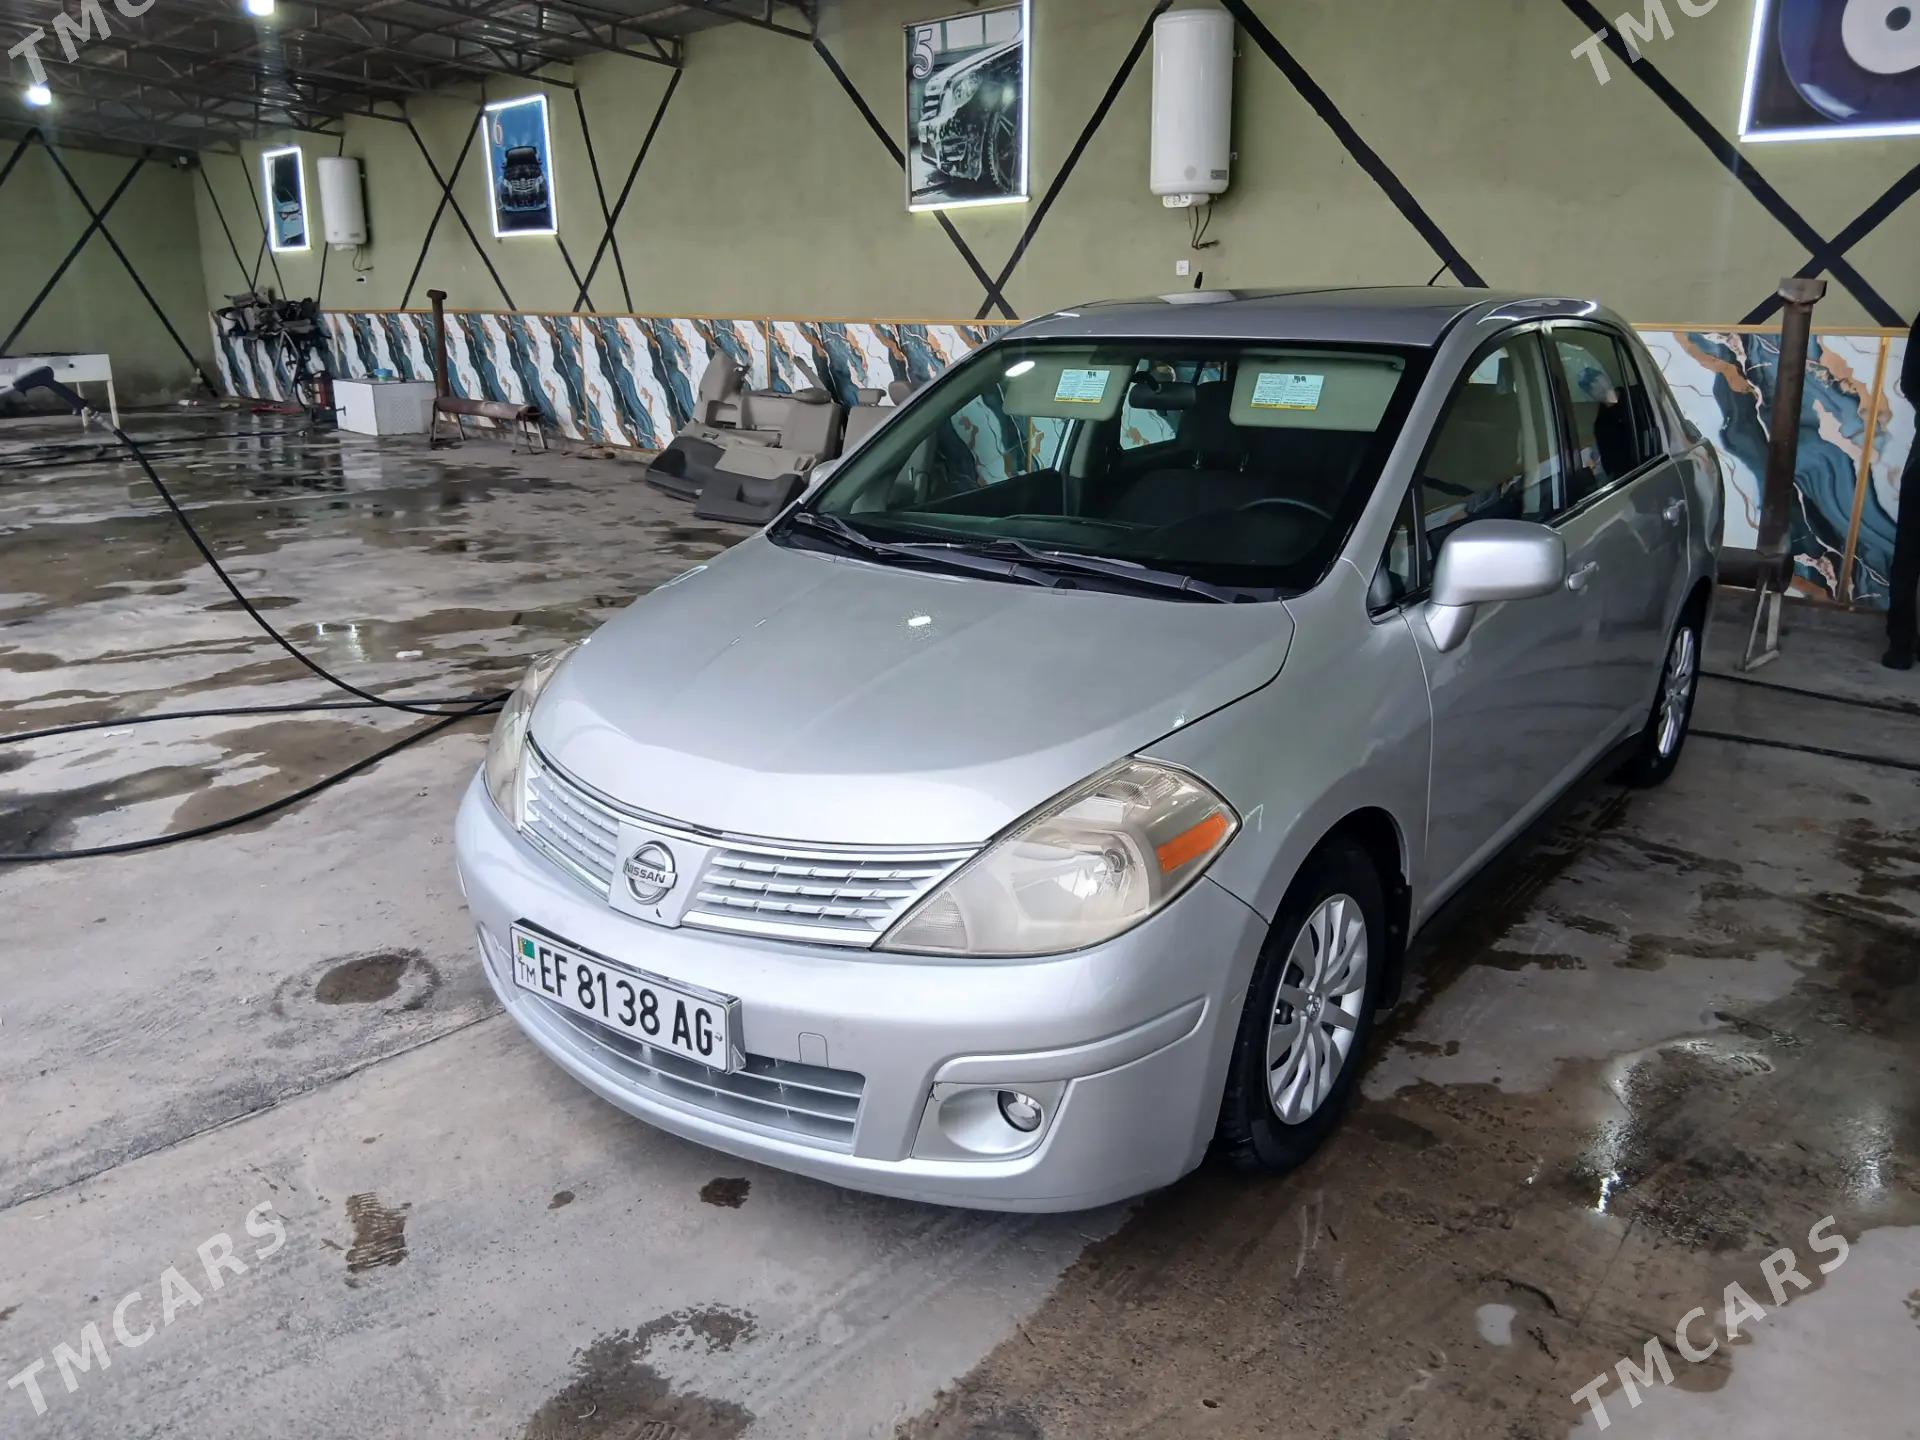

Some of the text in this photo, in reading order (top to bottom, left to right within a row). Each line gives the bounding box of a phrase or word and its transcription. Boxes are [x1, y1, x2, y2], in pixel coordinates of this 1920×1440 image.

[912, 28, 935, 79] 5
[493, 111, 503, 147] 6
[624, 862, 666, 884] NISSAN
[518, 960, 537, 986] TM
[538, 946, 568, 998] EF
[671, 999, 713, 1057] AG
